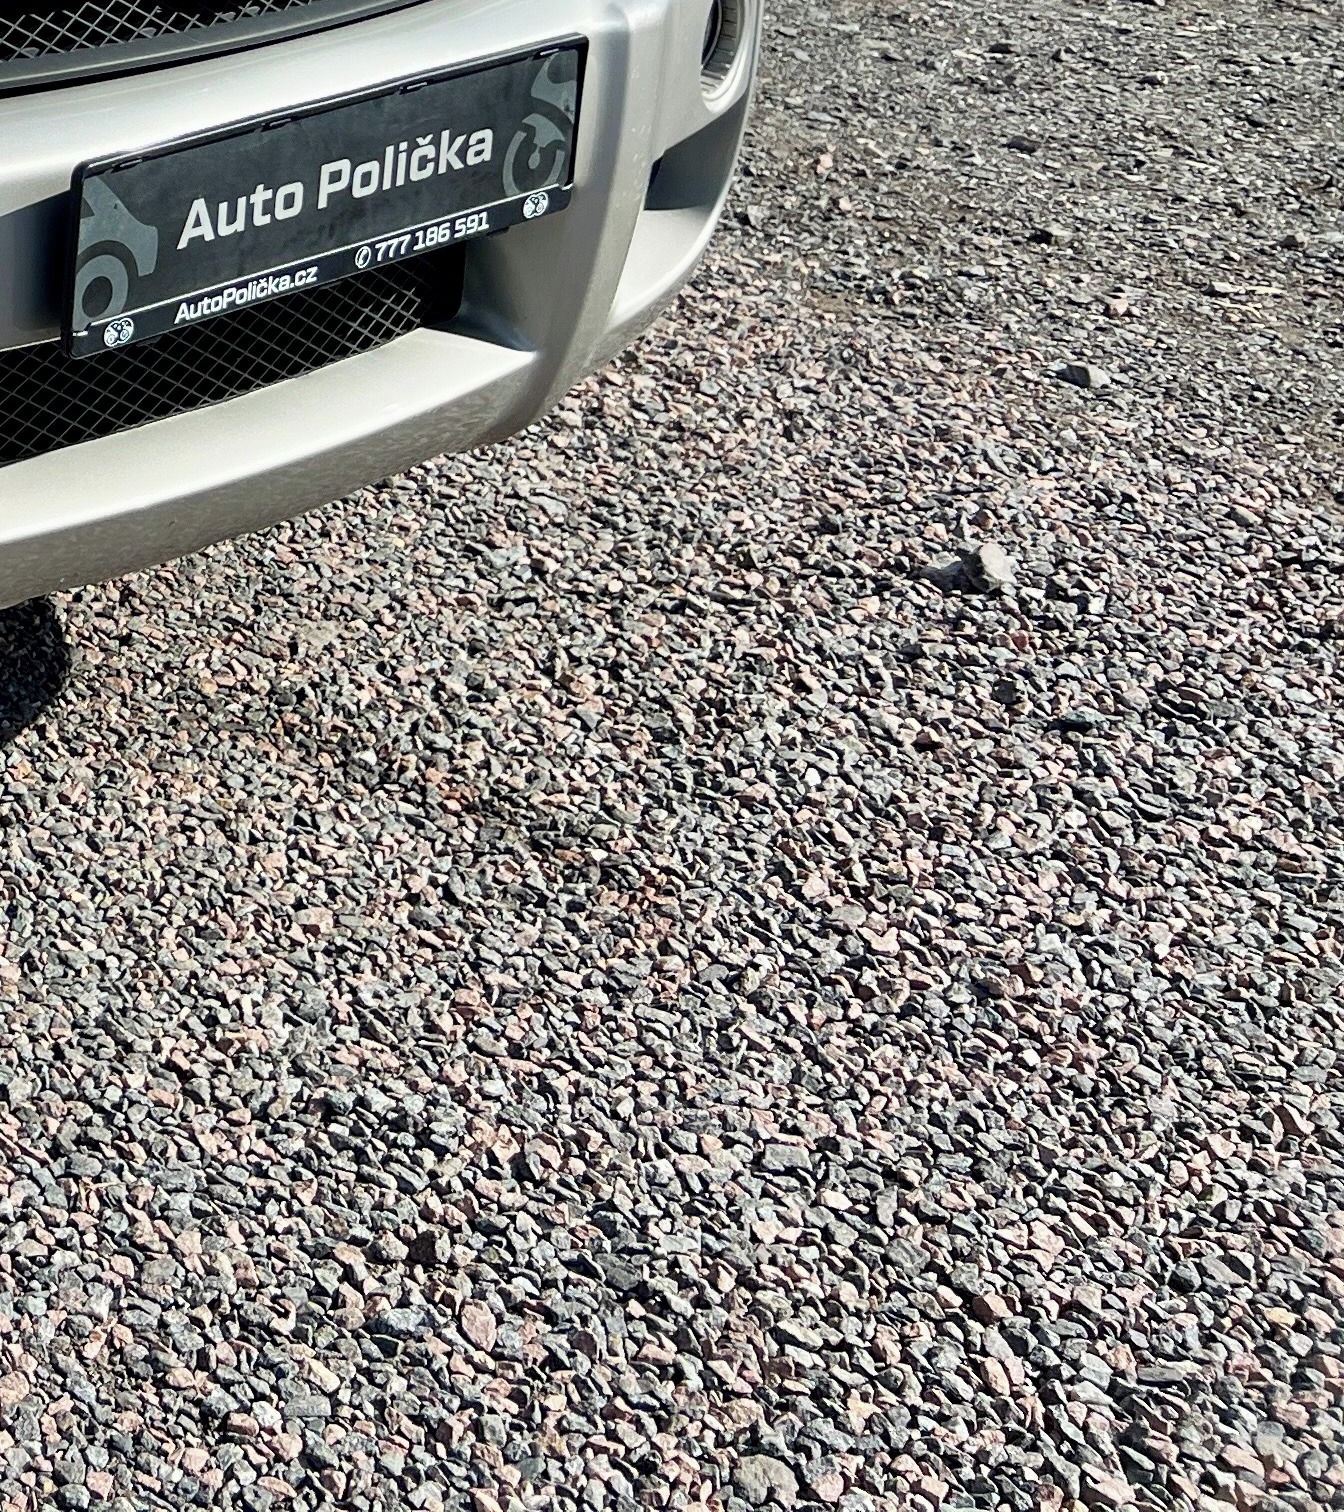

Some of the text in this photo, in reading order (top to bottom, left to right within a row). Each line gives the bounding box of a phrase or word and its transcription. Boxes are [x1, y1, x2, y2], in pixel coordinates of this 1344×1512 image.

[176, 128, 494, 250] Auto Polička
[375, 211, 489, 262] 777 186 591
[174, 266, 318, 324] AutoPolička.cz
